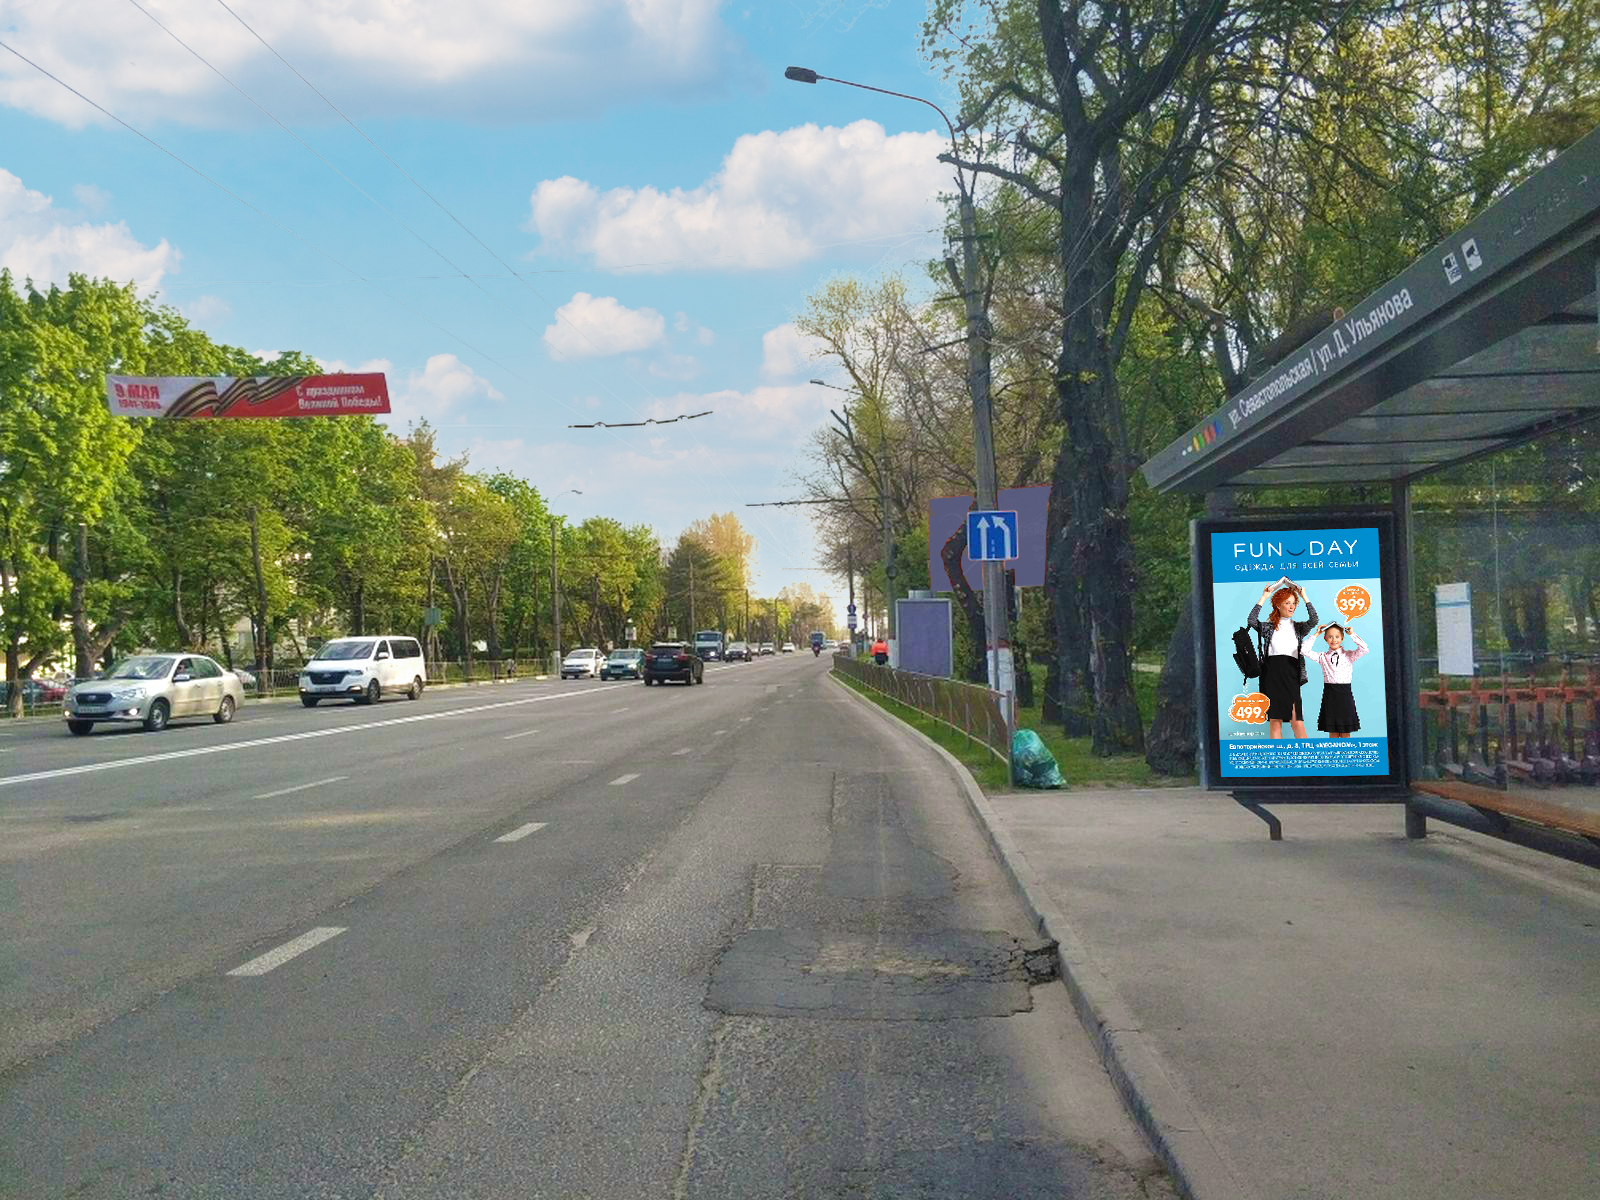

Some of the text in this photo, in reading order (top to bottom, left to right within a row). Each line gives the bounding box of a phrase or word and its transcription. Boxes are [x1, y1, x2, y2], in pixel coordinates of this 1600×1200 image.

[1345, 288, 1413, 344] Ульянова
[127, 384, 160, 399] МАЯ
[306, 385, 365, 398] праздником
[299, 398, 339, 410] Великой
[1234, 539, 1358, 558] FUN DAY
[1234, 560, 1359, 572] ОДЕЖДА ДЛЯ ВСЕЙ СЕМЬИ
